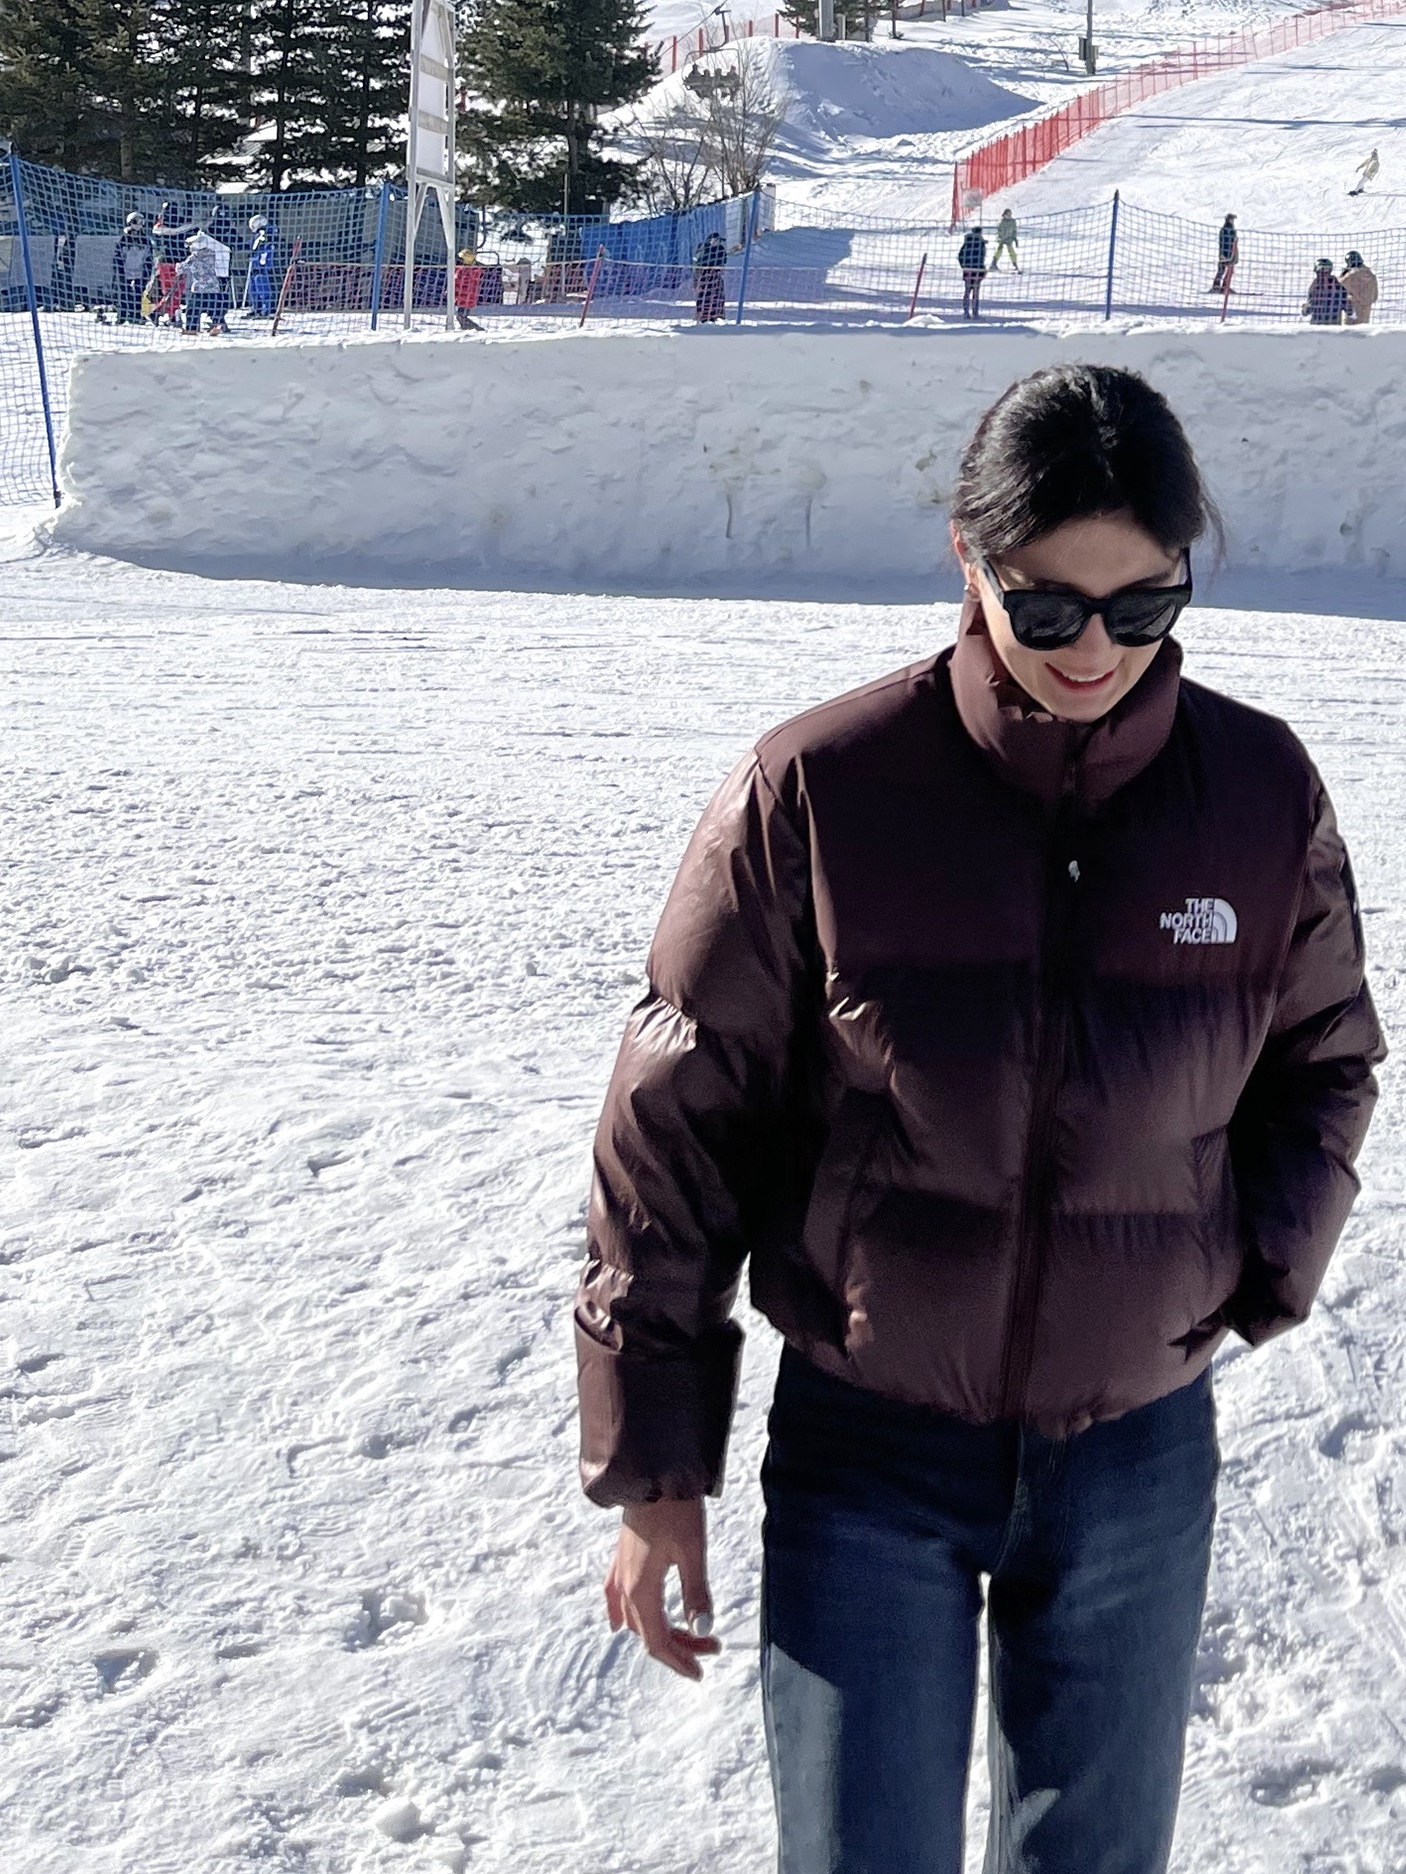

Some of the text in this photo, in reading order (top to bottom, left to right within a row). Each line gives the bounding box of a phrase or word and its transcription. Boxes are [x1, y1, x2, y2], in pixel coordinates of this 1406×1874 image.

[1185, 898, 1213, 913] THE
[1160, 912, 1213, 929] NORTH
[1173, 927, 1211, 944] FACE
